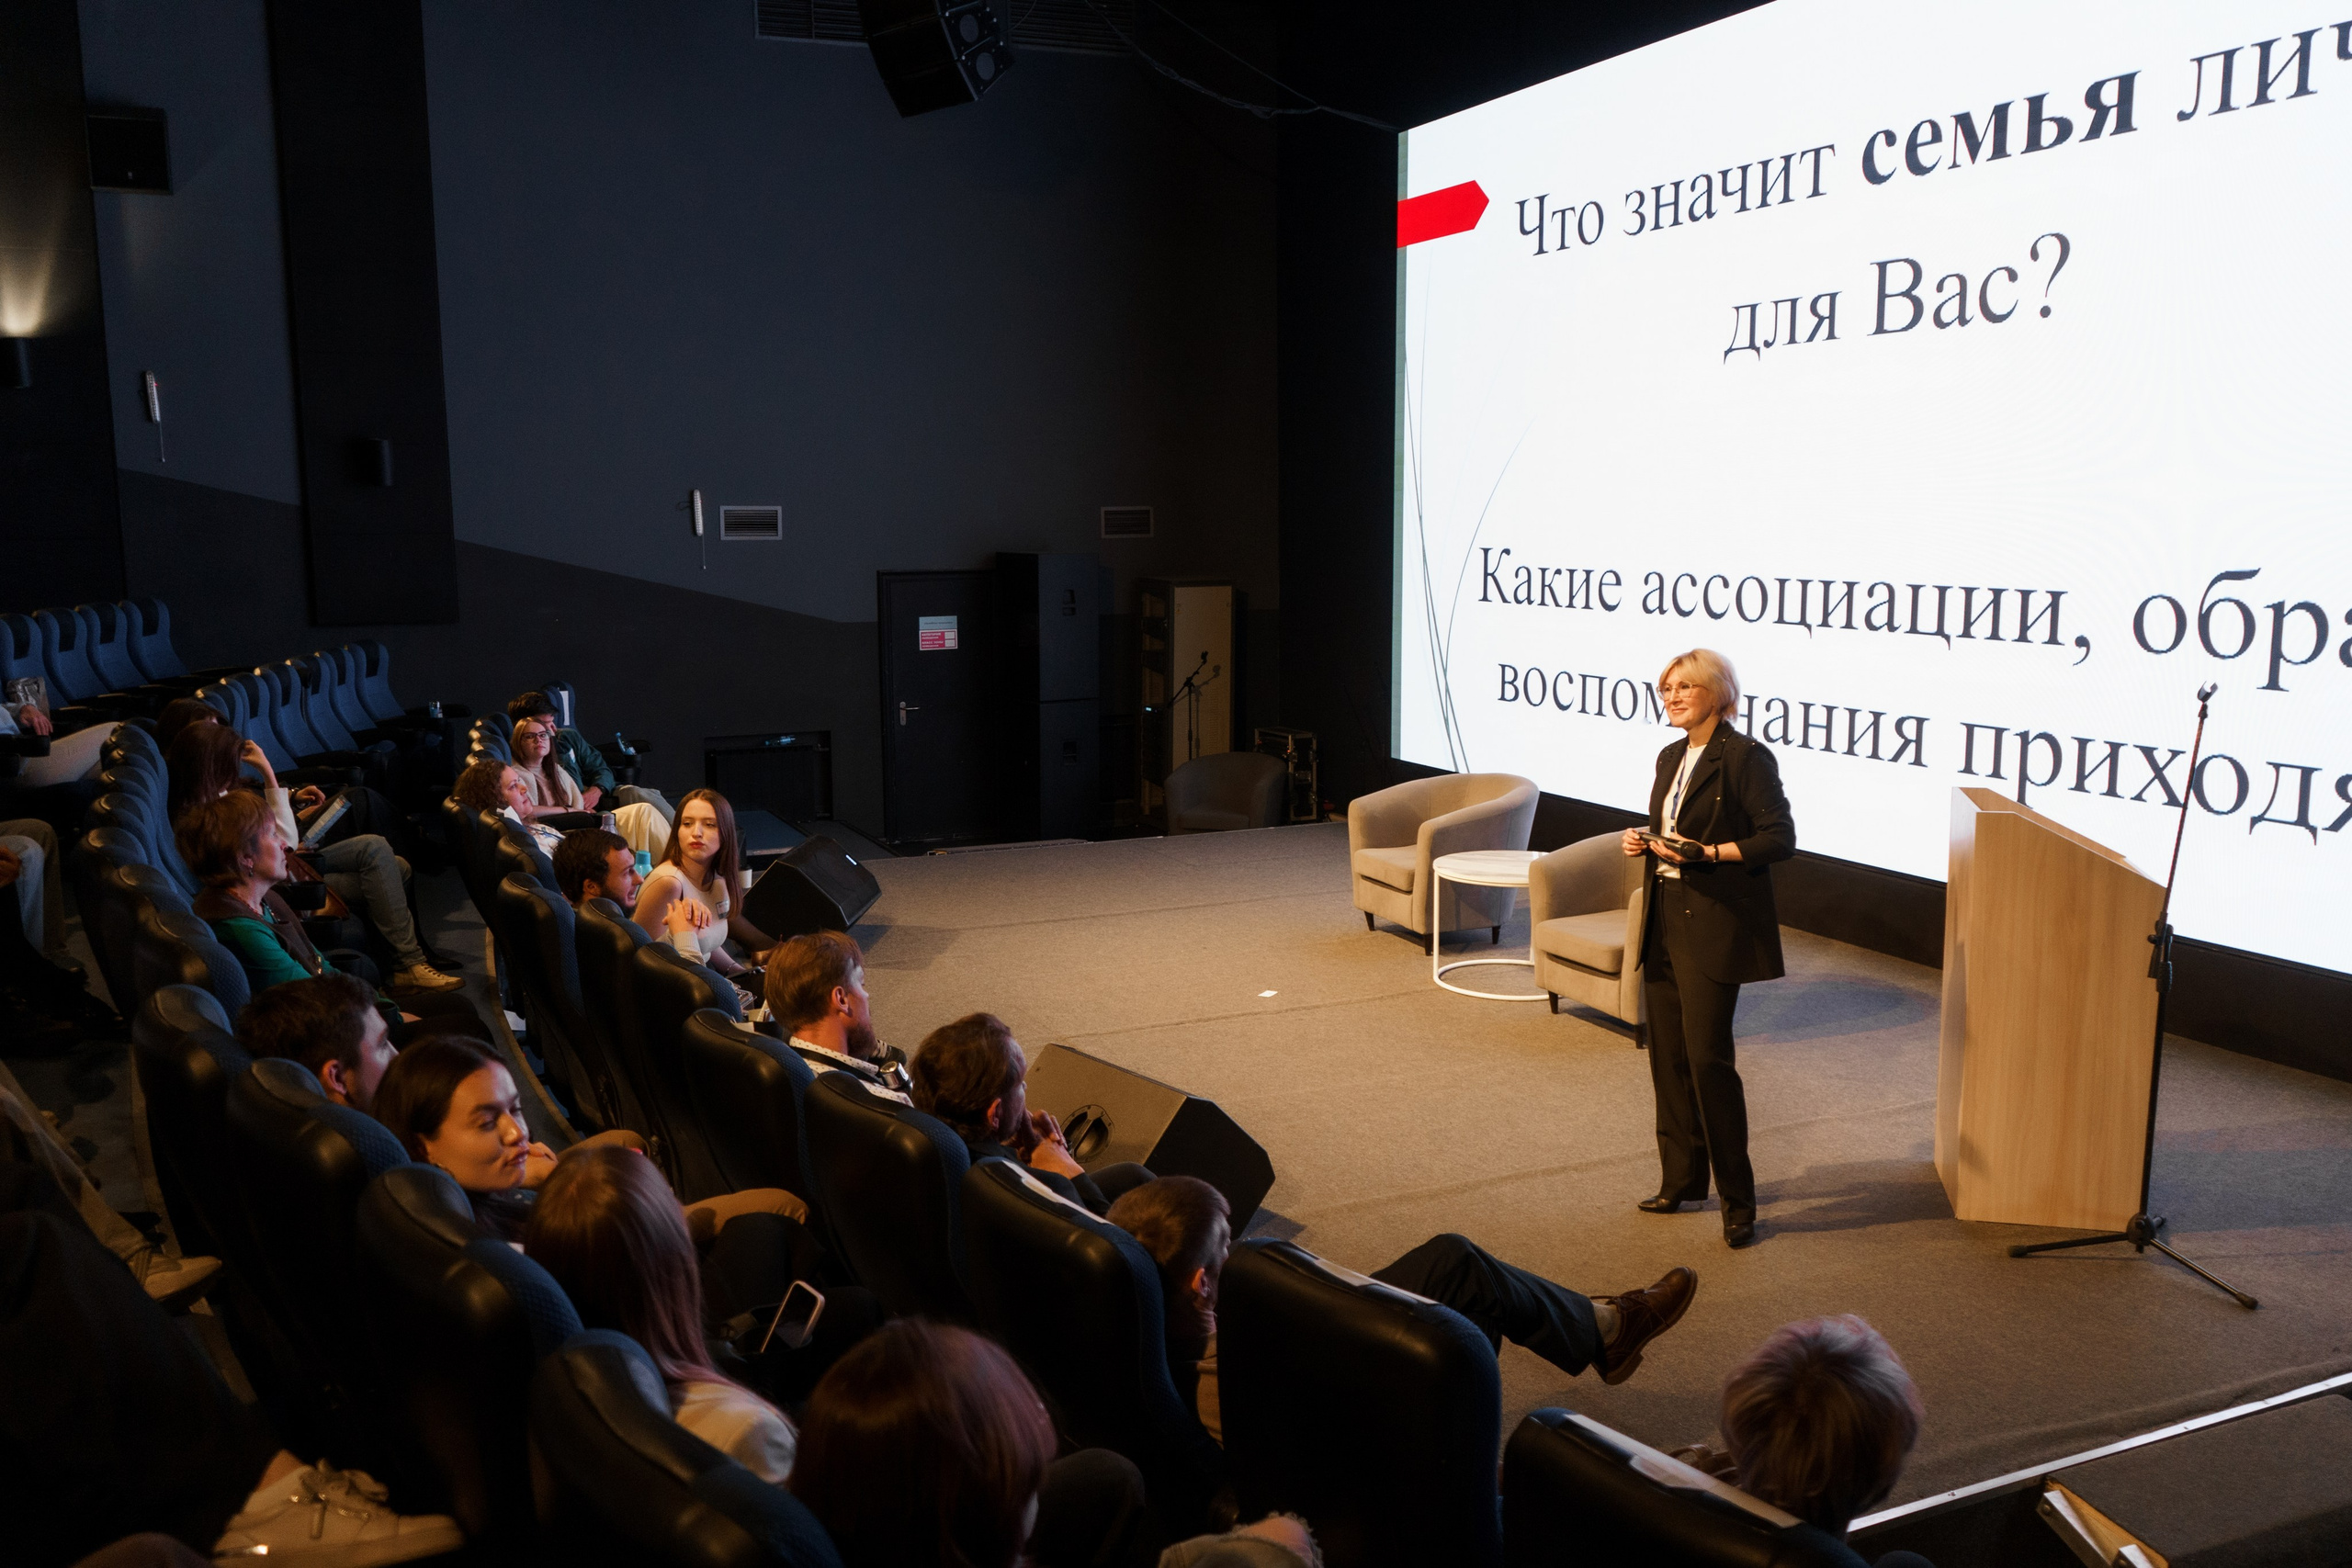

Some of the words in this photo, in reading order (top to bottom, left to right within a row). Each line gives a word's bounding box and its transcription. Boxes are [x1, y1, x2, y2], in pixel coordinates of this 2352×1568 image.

[1515, 193, 1605, 256] Что
[1624, 143, 1837, 237] значит
[1860, 70, 2142, 186] семья
[1723, 290, 1841, 364] для
[1867, 231, 2071, 336] Вас?
[1477, 547, 1623, 613] Какие
[1641, 570, 2092, 666] ассоциации,
[2132, 567, 2352, 693] обр
